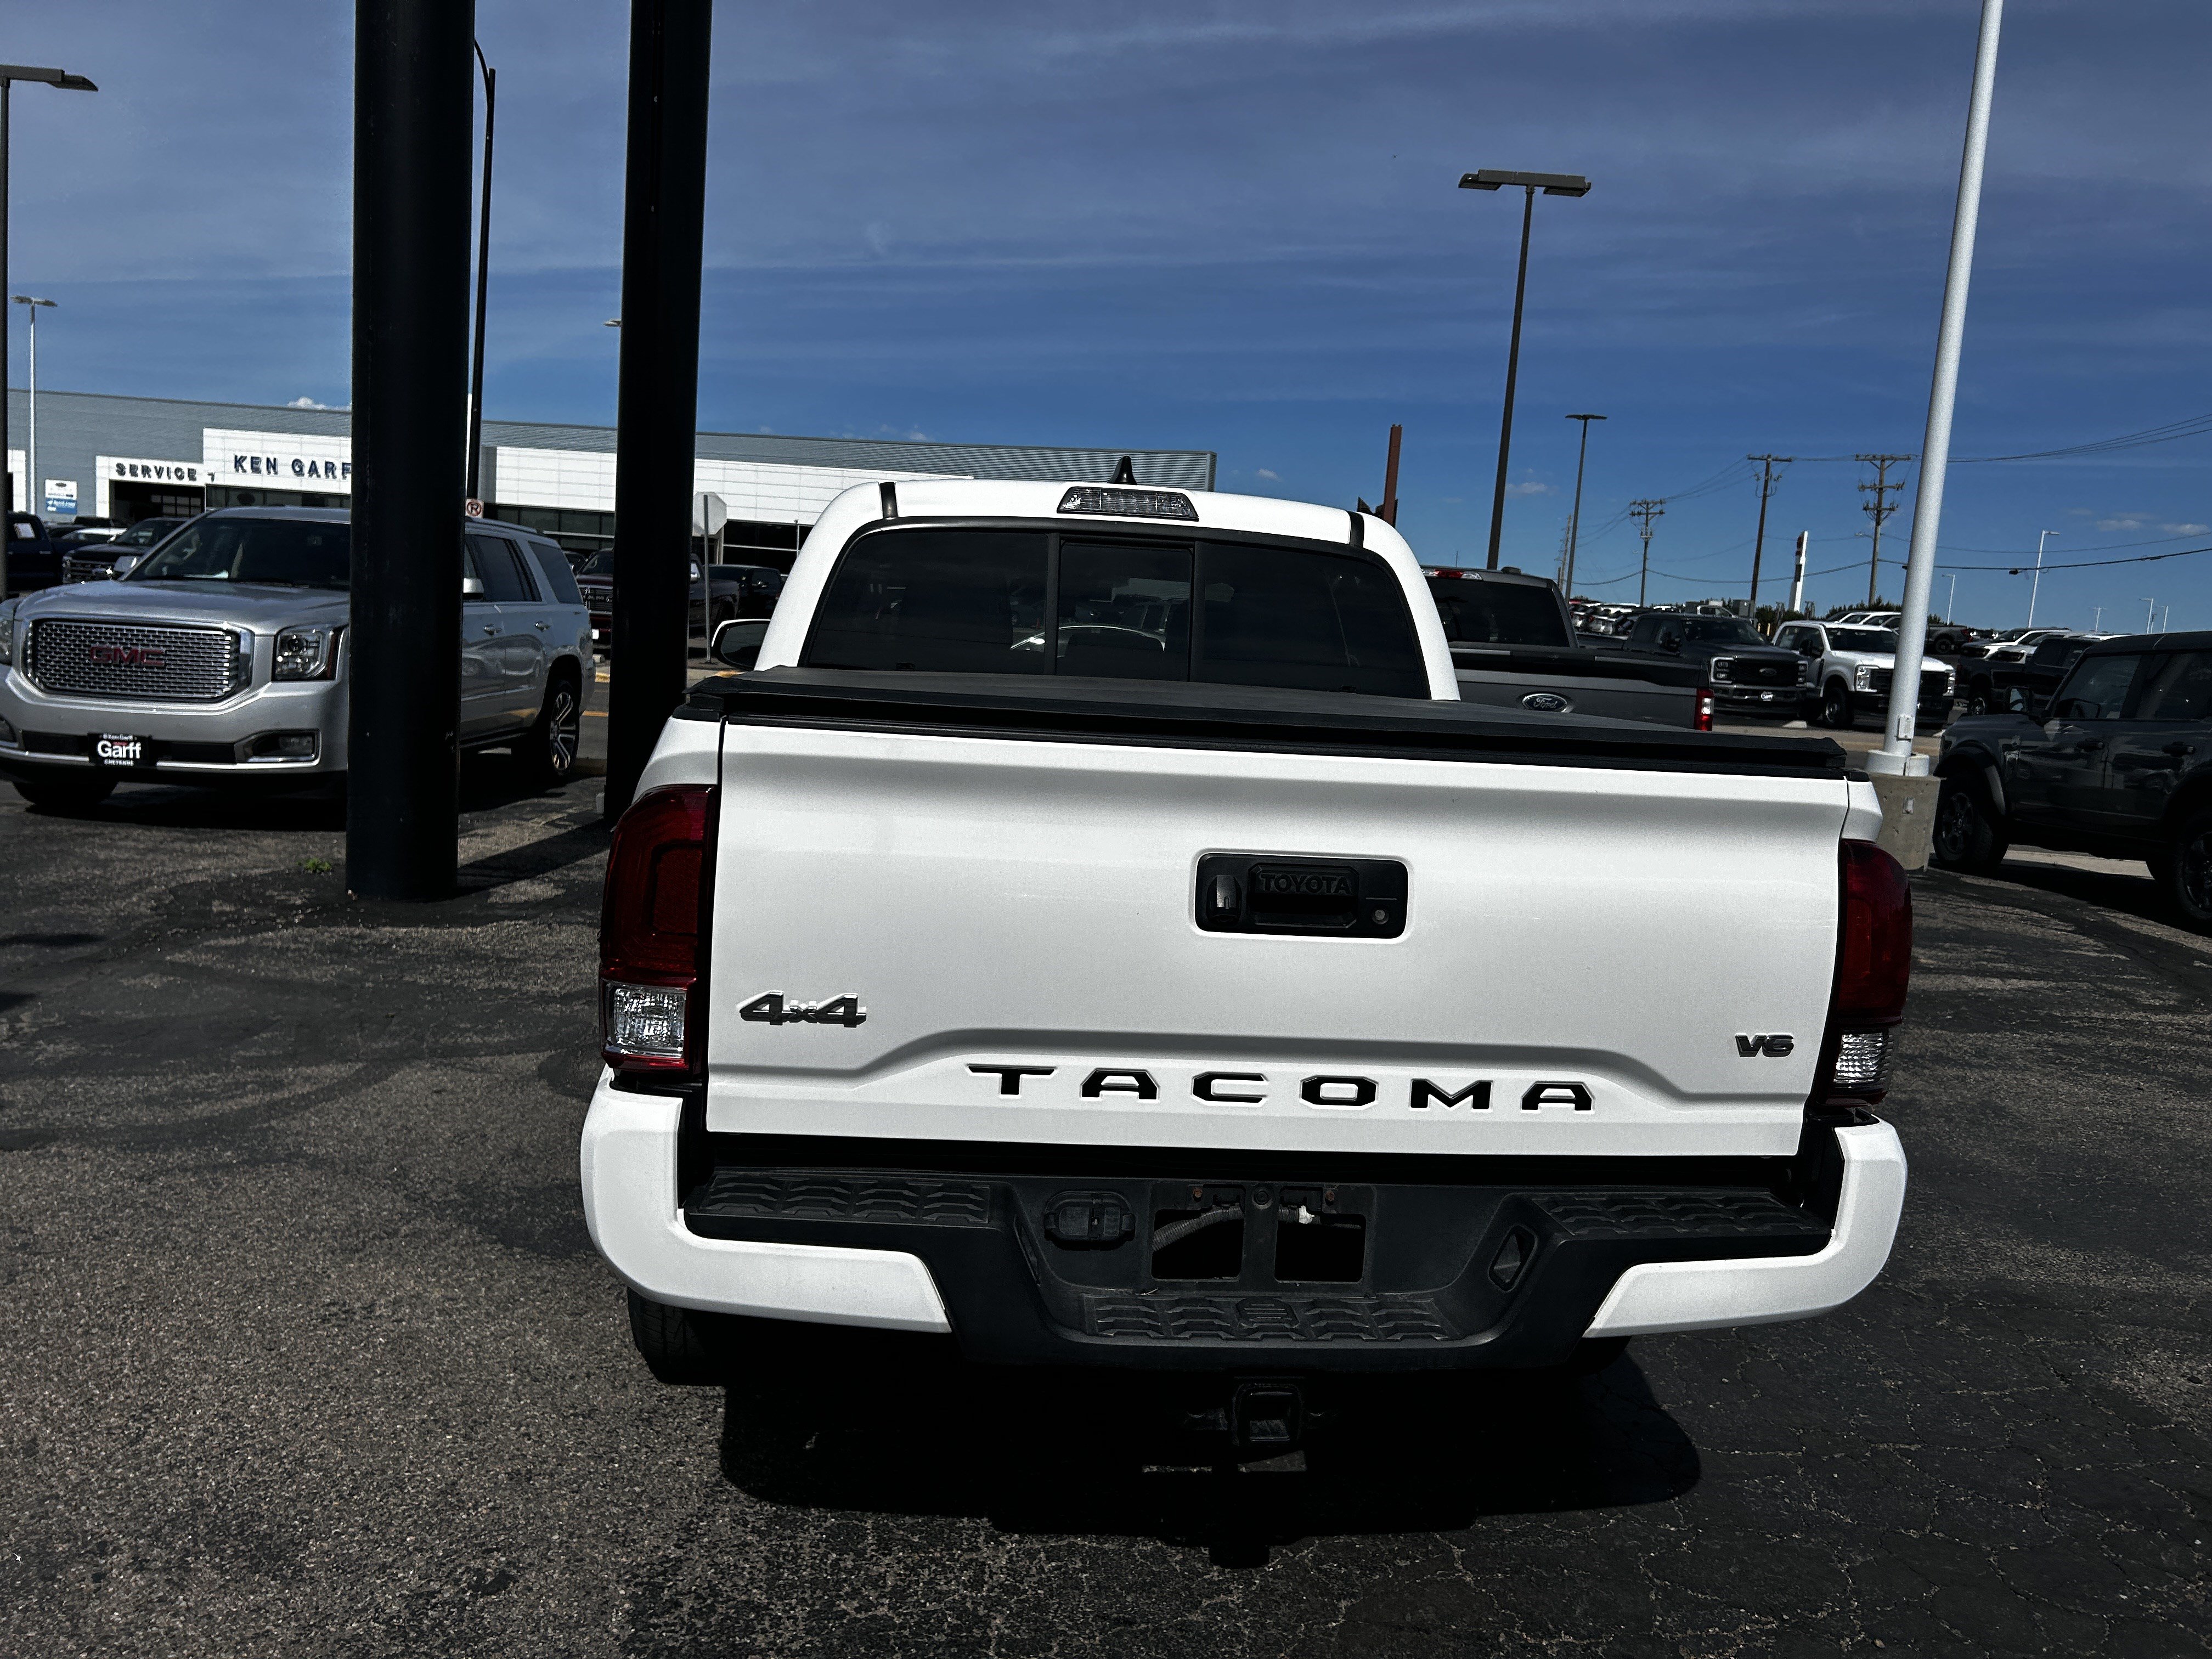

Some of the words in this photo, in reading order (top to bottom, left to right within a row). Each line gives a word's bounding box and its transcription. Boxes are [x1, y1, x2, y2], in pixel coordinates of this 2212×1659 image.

[116, 462, 197, 482] SERVICE
[234, 454, 279, 476] KEN
[90, 644, 166, 667] GMC
[97, 740, 142, 759] Garff
[1262, 873, 1352, 895] TOYOTA
[738, 989, 867, 1028] 4x4
[1735, 1033, 1795, 1058] V6
[966, 1063, 1595, 1111] TACOMA
